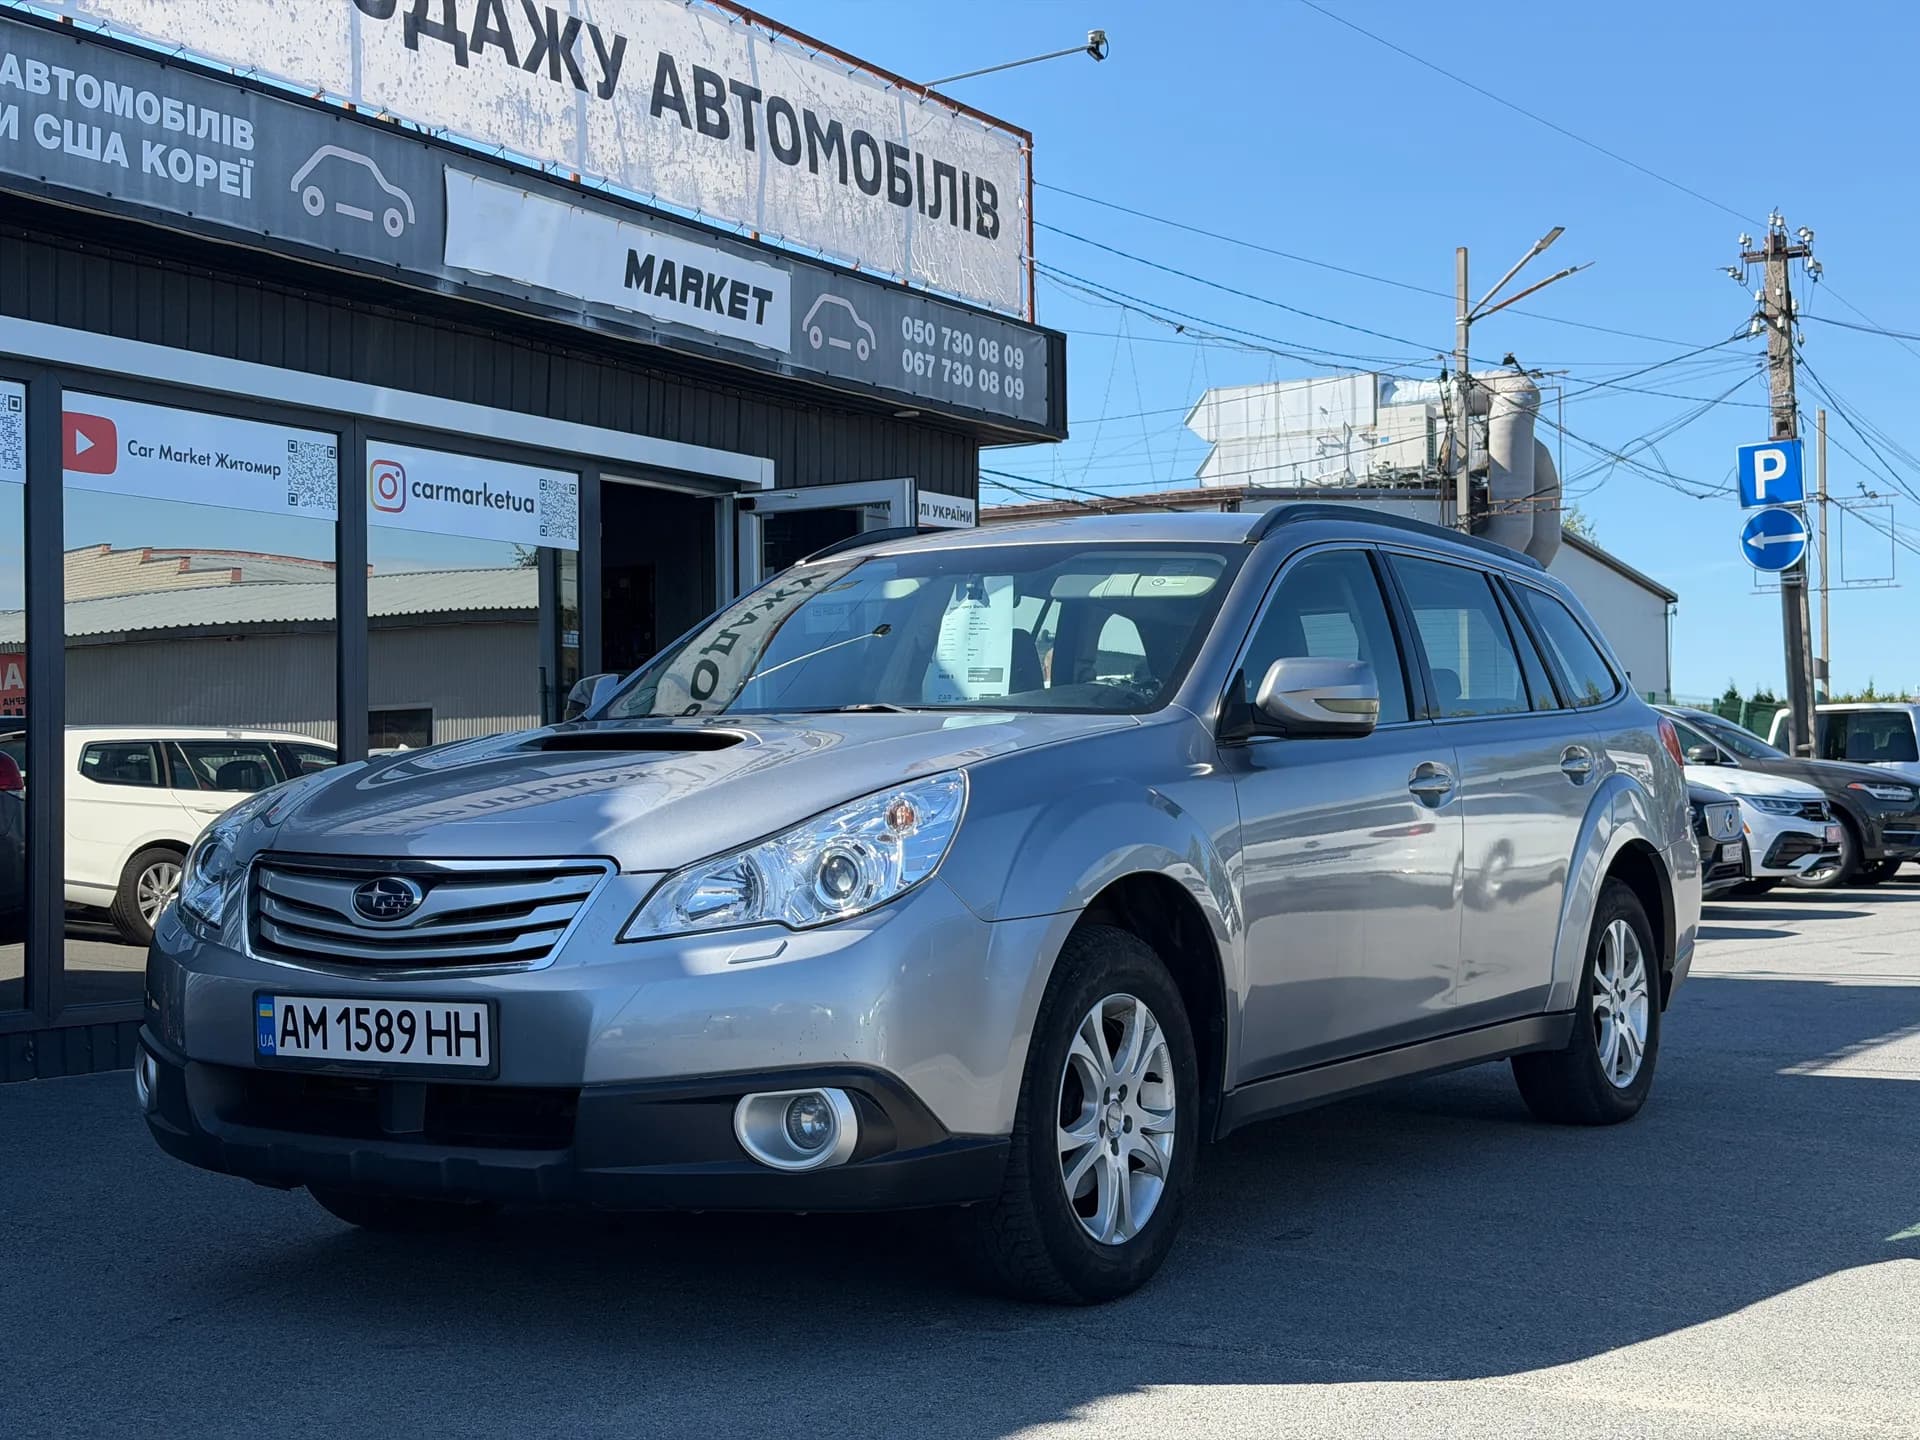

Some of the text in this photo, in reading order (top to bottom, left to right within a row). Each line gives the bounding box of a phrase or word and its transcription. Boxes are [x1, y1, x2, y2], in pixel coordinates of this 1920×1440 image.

[0, 53, 255, 151] АВТОМОБІЛІВ
[355, 0, 1001, 241] ДАЖУ АВТОМОБІЛІВ
[34, 113, 129, 169] США
[142, 140, 254, 199] КОРЕЇ
[624, 248, 773, 325] MARKET
[902, 316, 1024, 370] 050 730 08 09
[902, 349, 1024, 400] 067 730 08 09
[127, 440, 281, 480] Car Market Житомир
[1754, 449, 1786, 499] P
[411, 481, 534, 513] carmarketua
[932, 505, 972, 523] УКРАЇНИ
[260, 1004, 482, 1058] UA AM 1589 HH
